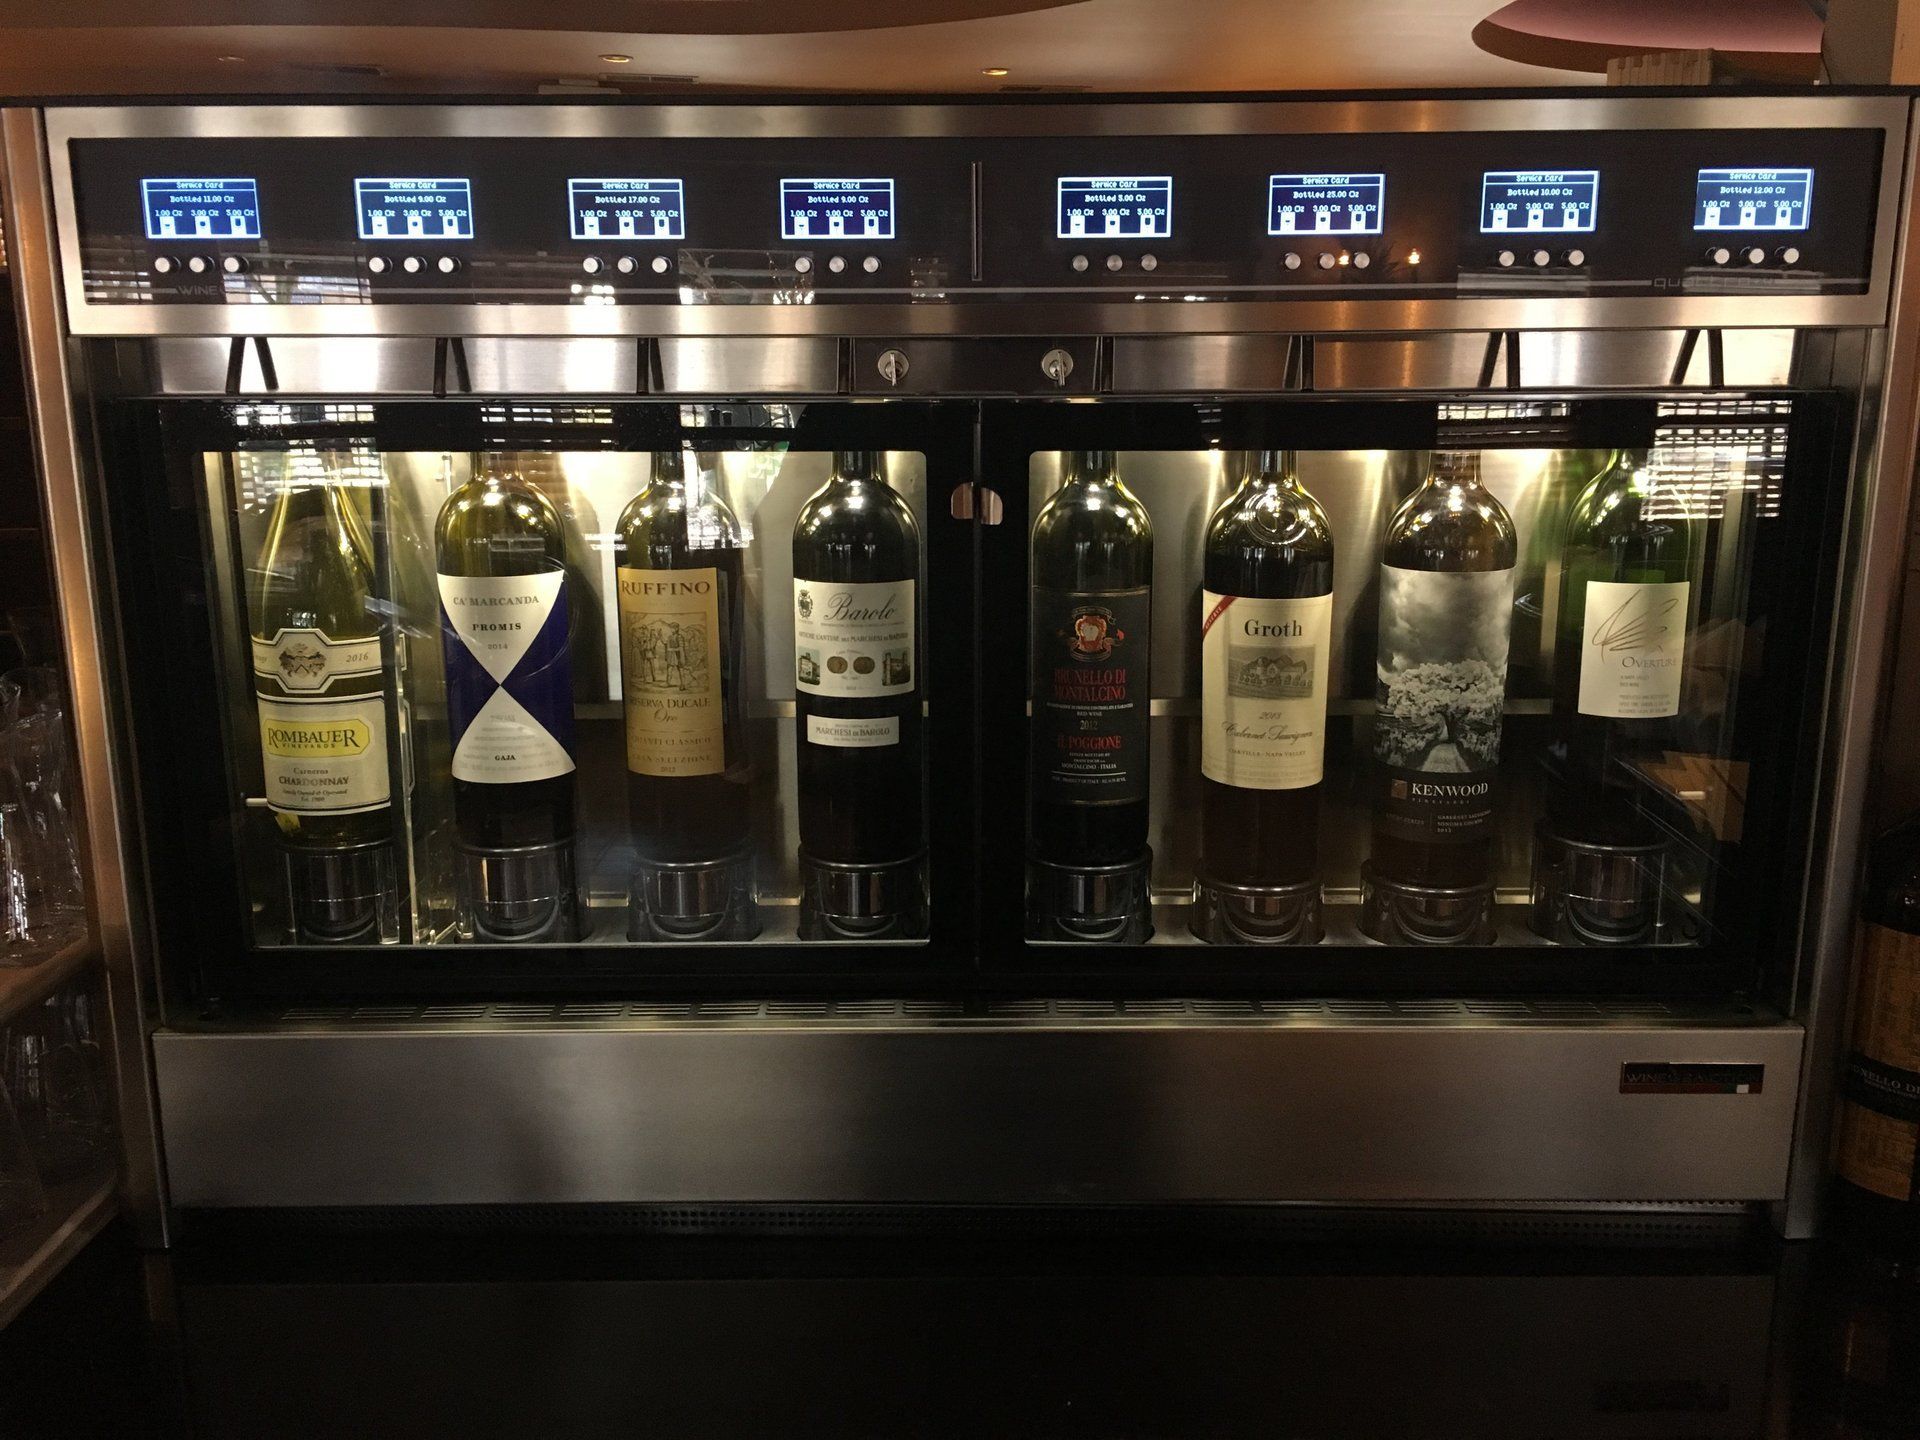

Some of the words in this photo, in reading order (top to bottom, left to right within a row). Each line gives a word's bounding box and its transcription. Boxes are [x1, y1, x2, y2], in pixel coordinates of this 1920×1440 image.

[1302, 176, 1329, 184] Service
[1331, 176, 1350, 184] Card
[1516, 174, 1543, 182] Service
[1544, 174, 1564, 182] Card
[177, 181, 202, 189] Service
[204, 181, 224, 189] Card
[389, 181, 416, 189] Service
[417, 181, 437, 189] Card
[602, 182, 628, 190] Service
[630, 182, 649, 190] Card
[813, 182, 840, 190] Service
[841, 182, 860, 190] Card
[1091, 181, 1117, 189] Service
[1119, 180, 1138, 188] Card
[1720, 186, 1752, 194] Bottled
[1774, 186, 1786, 194] Oz
[1085, 194, 1116, 202] Bottled
[1118, 194, 1134, 202] 5.00
[1135, 194, 1146, 202] Oz
[1293, 191, 1325, 199] Bottled
[1348, 190, 1359, 198] Oz
[224, 195, 235, 203] Oz
[384, 195, 417, 203] Bottled
[436, 195, 447, 203] Oz
[595, 196, 627, 204] Bottled
[1348, 204, 1363, 212] 5.00
[1365, 204, 1376, 212] Oz
[1525, 202, 1542, 210] 3.00
[1543, 202, 1554, 210] Oz
[1561, 202, 1577, 210] 5.00
[1702, 200, 1718, 208] 1.00
[1719, 200, 1730, 208] Oz
[1738, 200, 1754, 208] 3.00
[1755, 200, 1767, 208] Oz
[1773, 200, 1789, 208] 5.00
[1791, 200, 1802, 208] Oz
[1083, 208, 1094, 216] Oz
[1119, 208, 1130, 216] Oz
[1137, 208, 1153, 216] 5.00
[1277, 205, 1293, 213] 1.00
[1313, 205, 1329, 213] 3.00
[1330, 204, 1341, 212] Oz
[155, 209, 171, 217] 1.00
[172, 209, 183, 217] Oz
[190, 209, 206, 217] 3.00
[208, 209, 220, 217] Oz
[226, 209, 242, 217] 5.00
[368, 209, 383, 217] 1.00
[384, 209, 396, 217] Oz
[403, 209, 419, 217] 3.00
[420, 209, 432, 217] Oz
[438, 209, 455, 217] 5.00
[456, 209, 468, 217] Oz
[579, 210, 595, 218] 1.00
[615, 210, 631, 218] 3.00
[650, 210, 666, 218] 5.00
[790, 210, 806, 218] 1.00
[825, 210, 841, 218] 3.00
[622, 580, 711, 596] RUFFINO
[469, 596, 540, 606] MARCANDA
[823, 592, 897, 621] Barolo
[472, 622, 522, 632] PROMIS
[1244, 618, 1303, 638] Groth
[487, 643, 509, 651] 2014
[345, 653, 370, 664] 2016
[1055, 668, 1113, 685] BRUNELLO
[1115, 668, 1126, 684] DI
[1055, 684, 1127, 701] MONTALCINO
[667, 698, 711, 709] DUCALE
[1079, 719, 1099, 730] 2012
[816, 726, 851, 737] MARCHESI
[859, 727, 891, 737] BAROLO
[267, 728, 361, 749] ROMBAUER
[665, 736, 712, 746] CLASSICO
[1068, 735, 1123, 752] POGGIONE
[494, 753, 517, 762] GAJA
[278, 776, 351, 787] CHARDONNAY
[1411, 782, 1489, 798] KENWOOD
